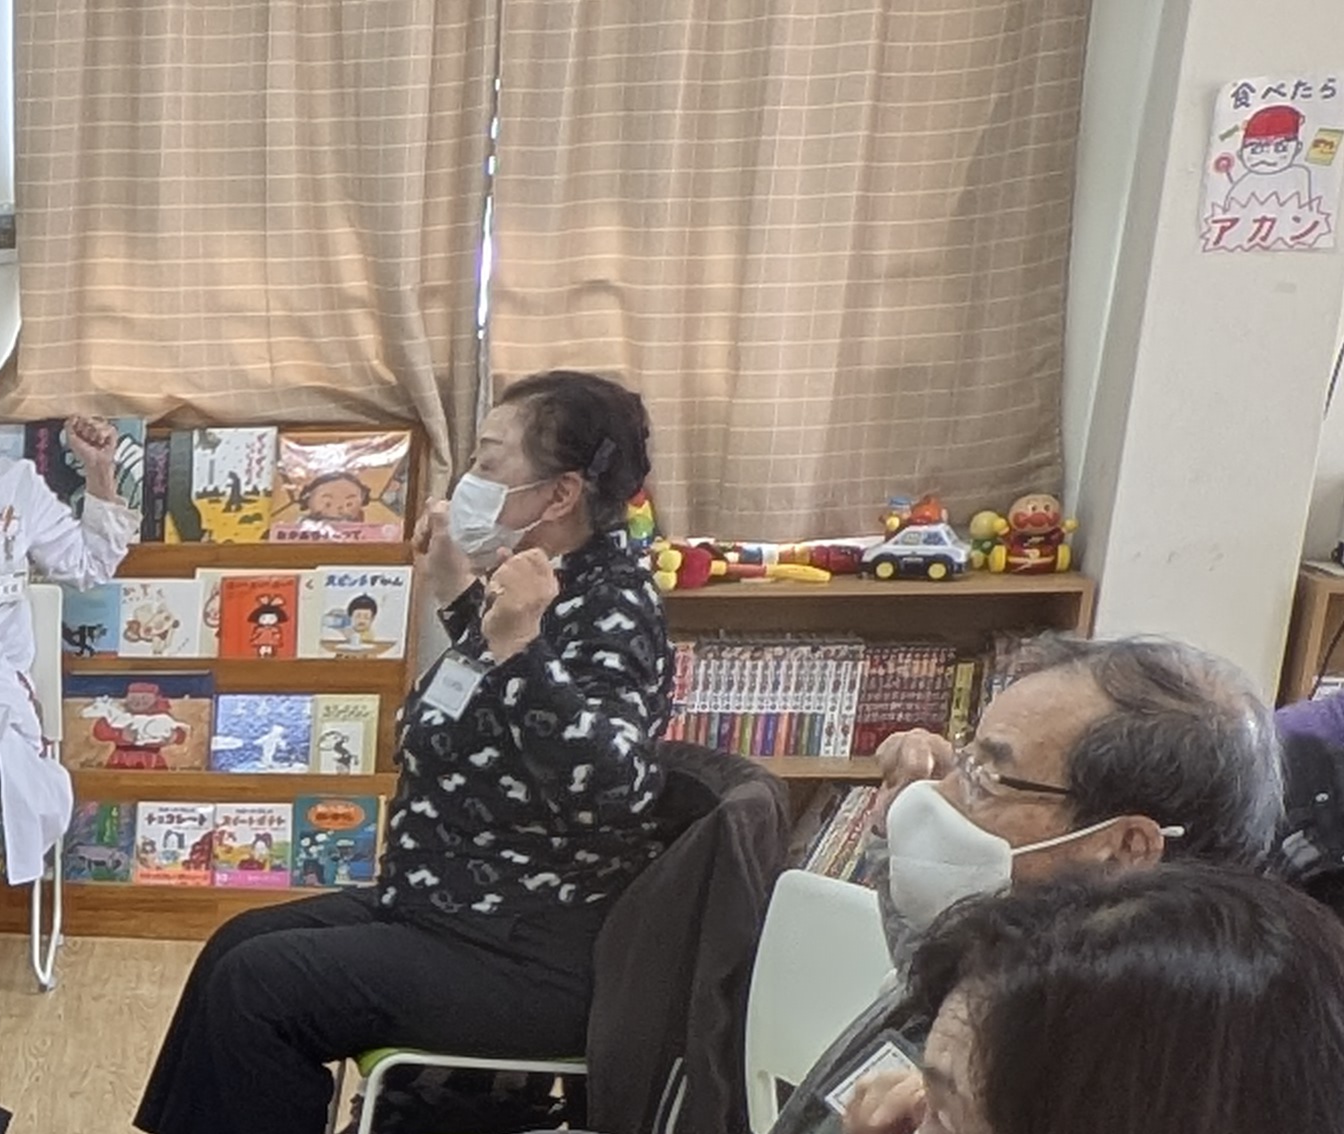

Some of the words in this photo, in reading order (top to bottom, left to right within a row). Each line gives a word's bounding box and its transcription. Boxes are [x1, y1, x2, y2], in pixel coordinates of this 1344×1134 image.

[1230, 78, 1337, 109] 食べたら
[1212, 215, 1320, 246] アカン
